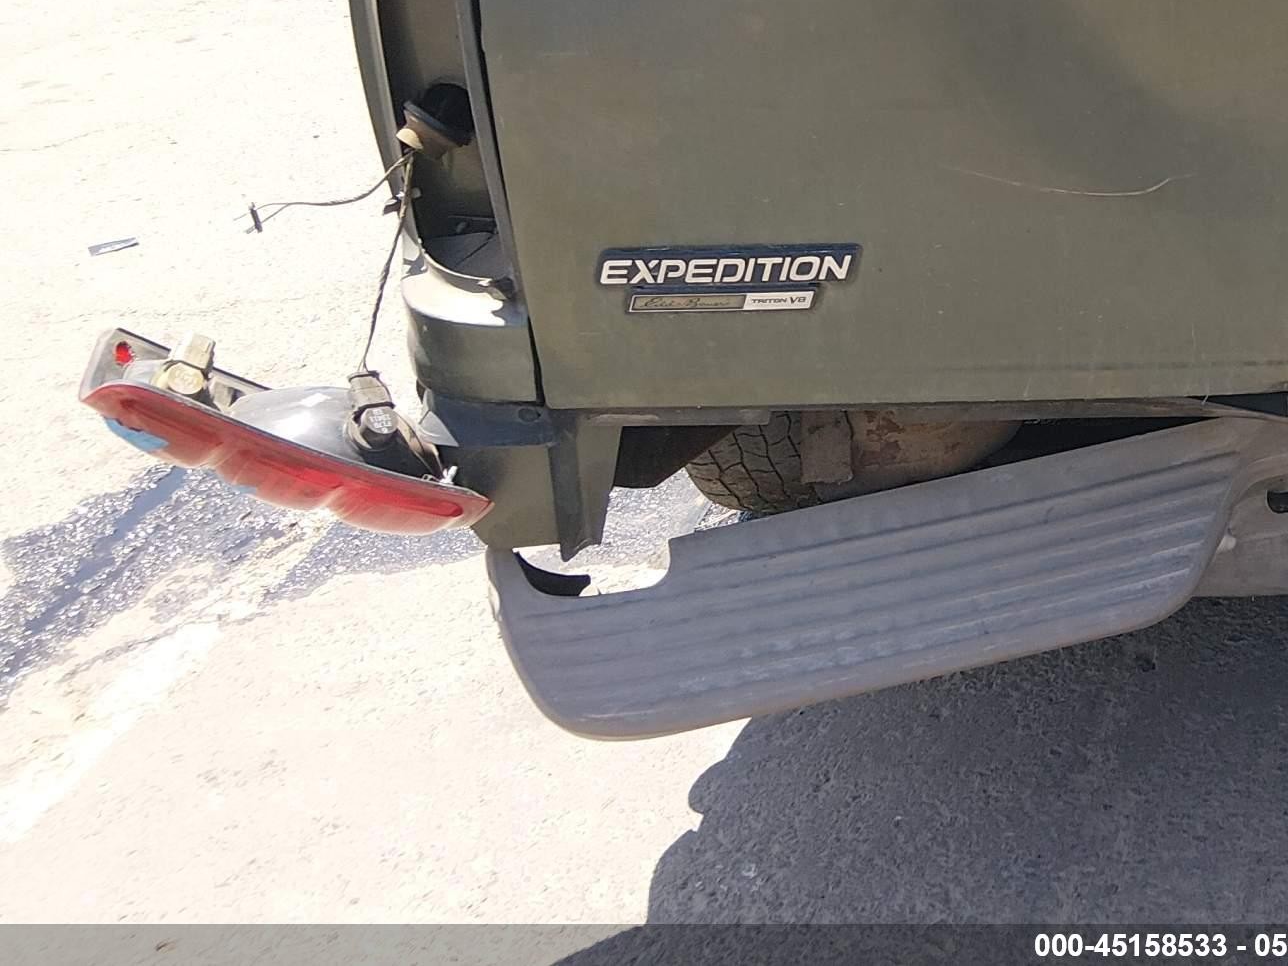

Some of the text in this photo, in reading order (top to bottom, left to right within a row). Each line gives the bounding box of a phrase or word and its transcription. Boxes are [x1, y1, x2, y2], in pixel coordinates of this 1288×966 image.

[600, 255, 852, 285] EXPEDITION
[751, 295, 808, 305] TRITON V8
